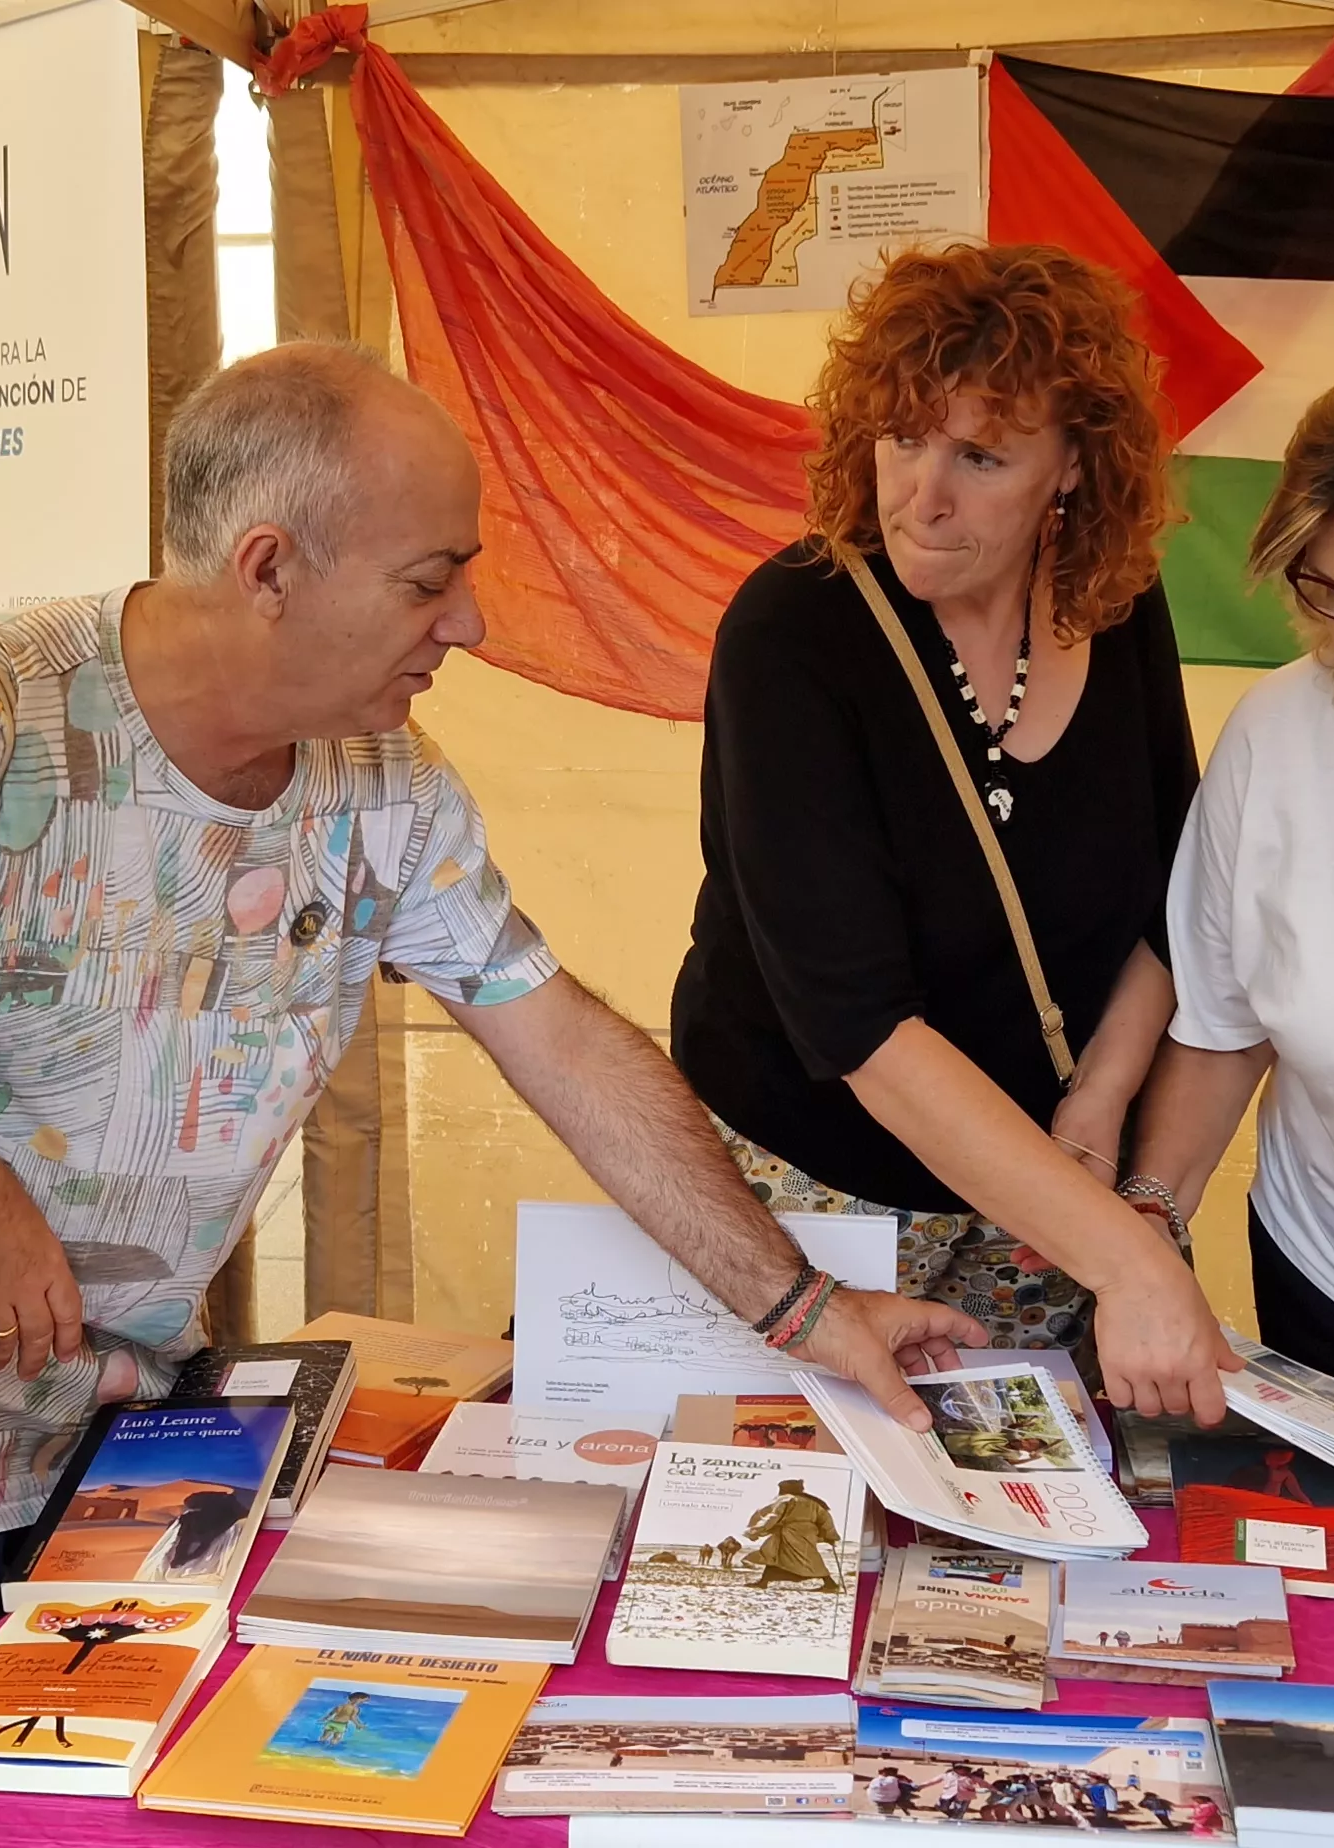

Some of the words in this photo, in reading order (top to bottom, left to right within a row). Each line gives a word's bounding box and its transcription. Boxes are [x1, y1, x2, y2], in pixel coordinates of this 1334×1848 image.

[25, 337, 46, 363] LA
[62, 377, 87, 403] DE
[119, 1418, 154, 1429] Luis
[159, 1416, 216, 1426] Leante
[113, 1432, 145, 1441] Mira
[161, 1431, 179, 1440] yo
[183, 1429, 196, 1437] te
[199, 1427, 243, 1438] querré
[506, 1435, 547, 1447] tiza
[557, 1440, 571, 1450] y
[581, 1441, 649, 1454] arena
[670, 1452, 695, 1464] La
[702, 1457, 781, 1470] zancada
[668, 1464, 696, 1476] del
[917, 1585, 960, 1596] LIBRE
[964, 1592, 1029, 1603] SAHARA
[1121, 1587, 1225, 1598] alouda
[915, 1600, 1000, 1617] alouda
[317, 1649, 335, 1659] EL
[341, 1650, 380, 1664] NIÑO
[385, 1655, 413, 1667] DEL
[419, 1658, 499, 1673] DESIERTO
